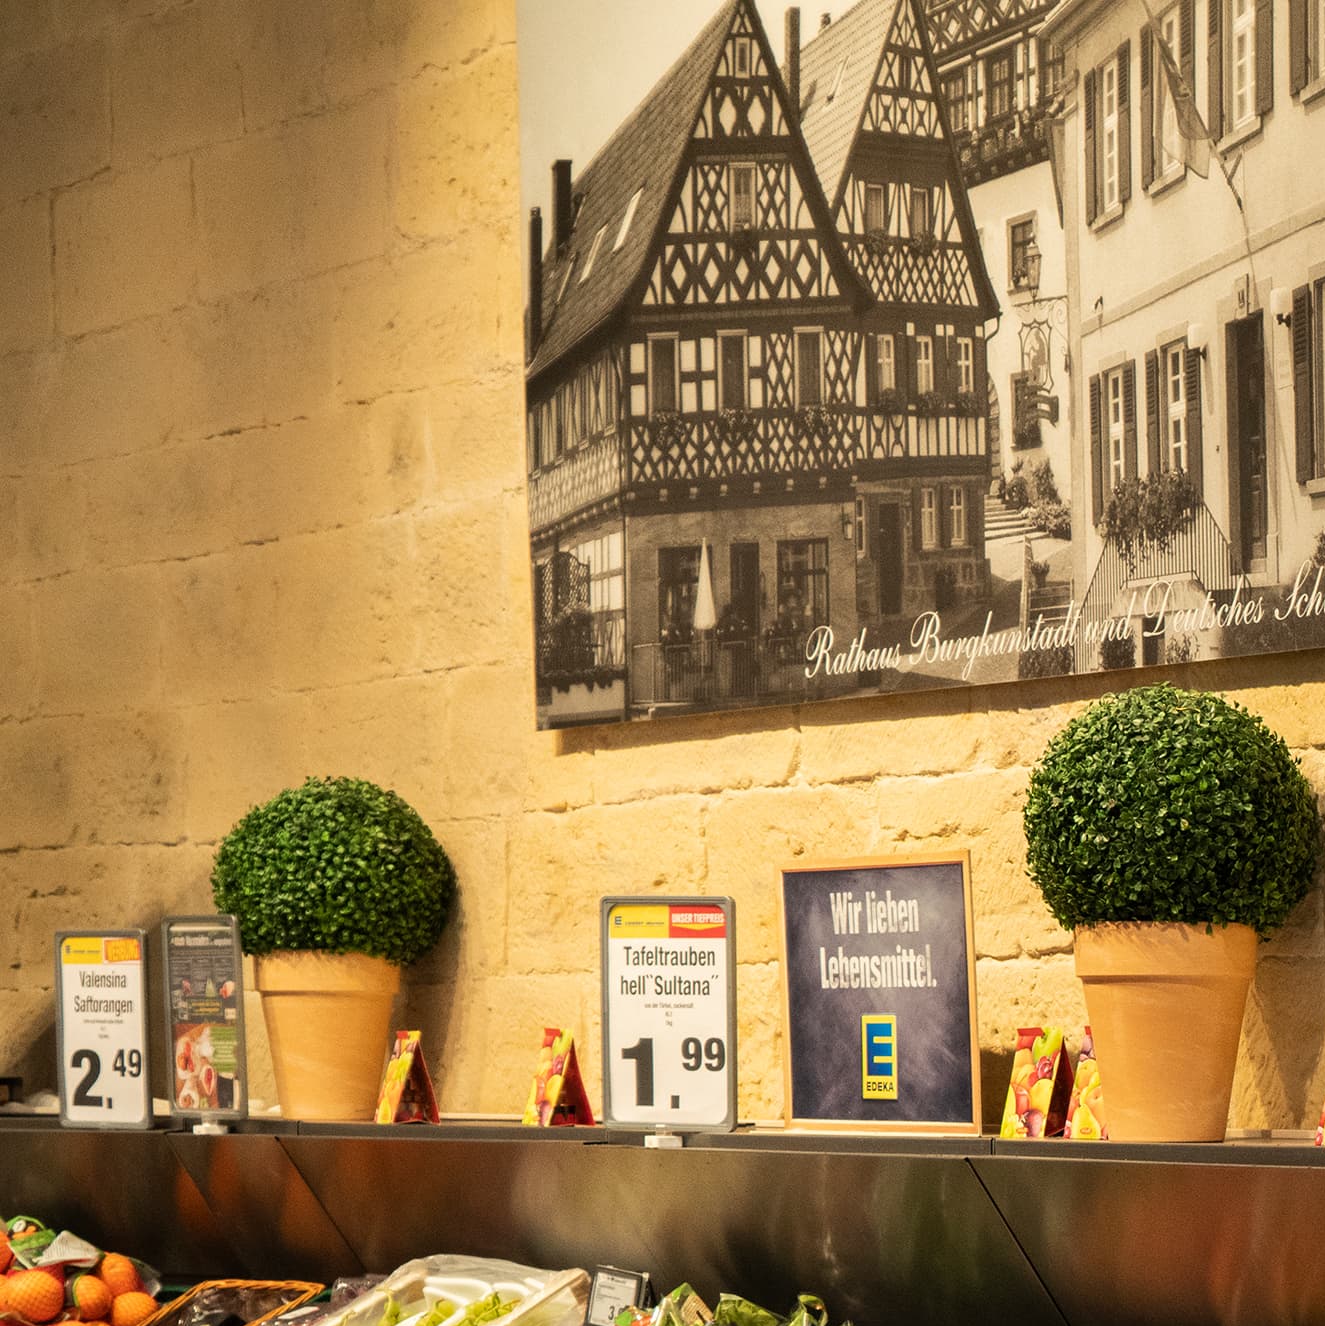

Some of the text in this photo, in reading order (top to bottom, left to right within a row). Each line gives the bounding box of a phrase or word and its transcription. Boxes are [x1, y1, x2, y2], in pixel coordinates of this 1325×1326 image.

[806, 625, 902, 678] Rathaus
[909, 600, 1083, 681] Burgkunstadt
[1084, 591, 1137, 641] und
[1143, 577, 1264, 638] Deutsches
[829, 890, 920, 935] Wir lieben
[623, 946, 716, 967] Tafeltrauben
[820, 944, 937, 989] Lebensmittel.
[79, 970, 128, 988] Valensina
[74, 995, 133, 1016] Saftorangen
[866, 1023, 892, 1076] E
[866, 1081, 894, 1091] EDEKA
